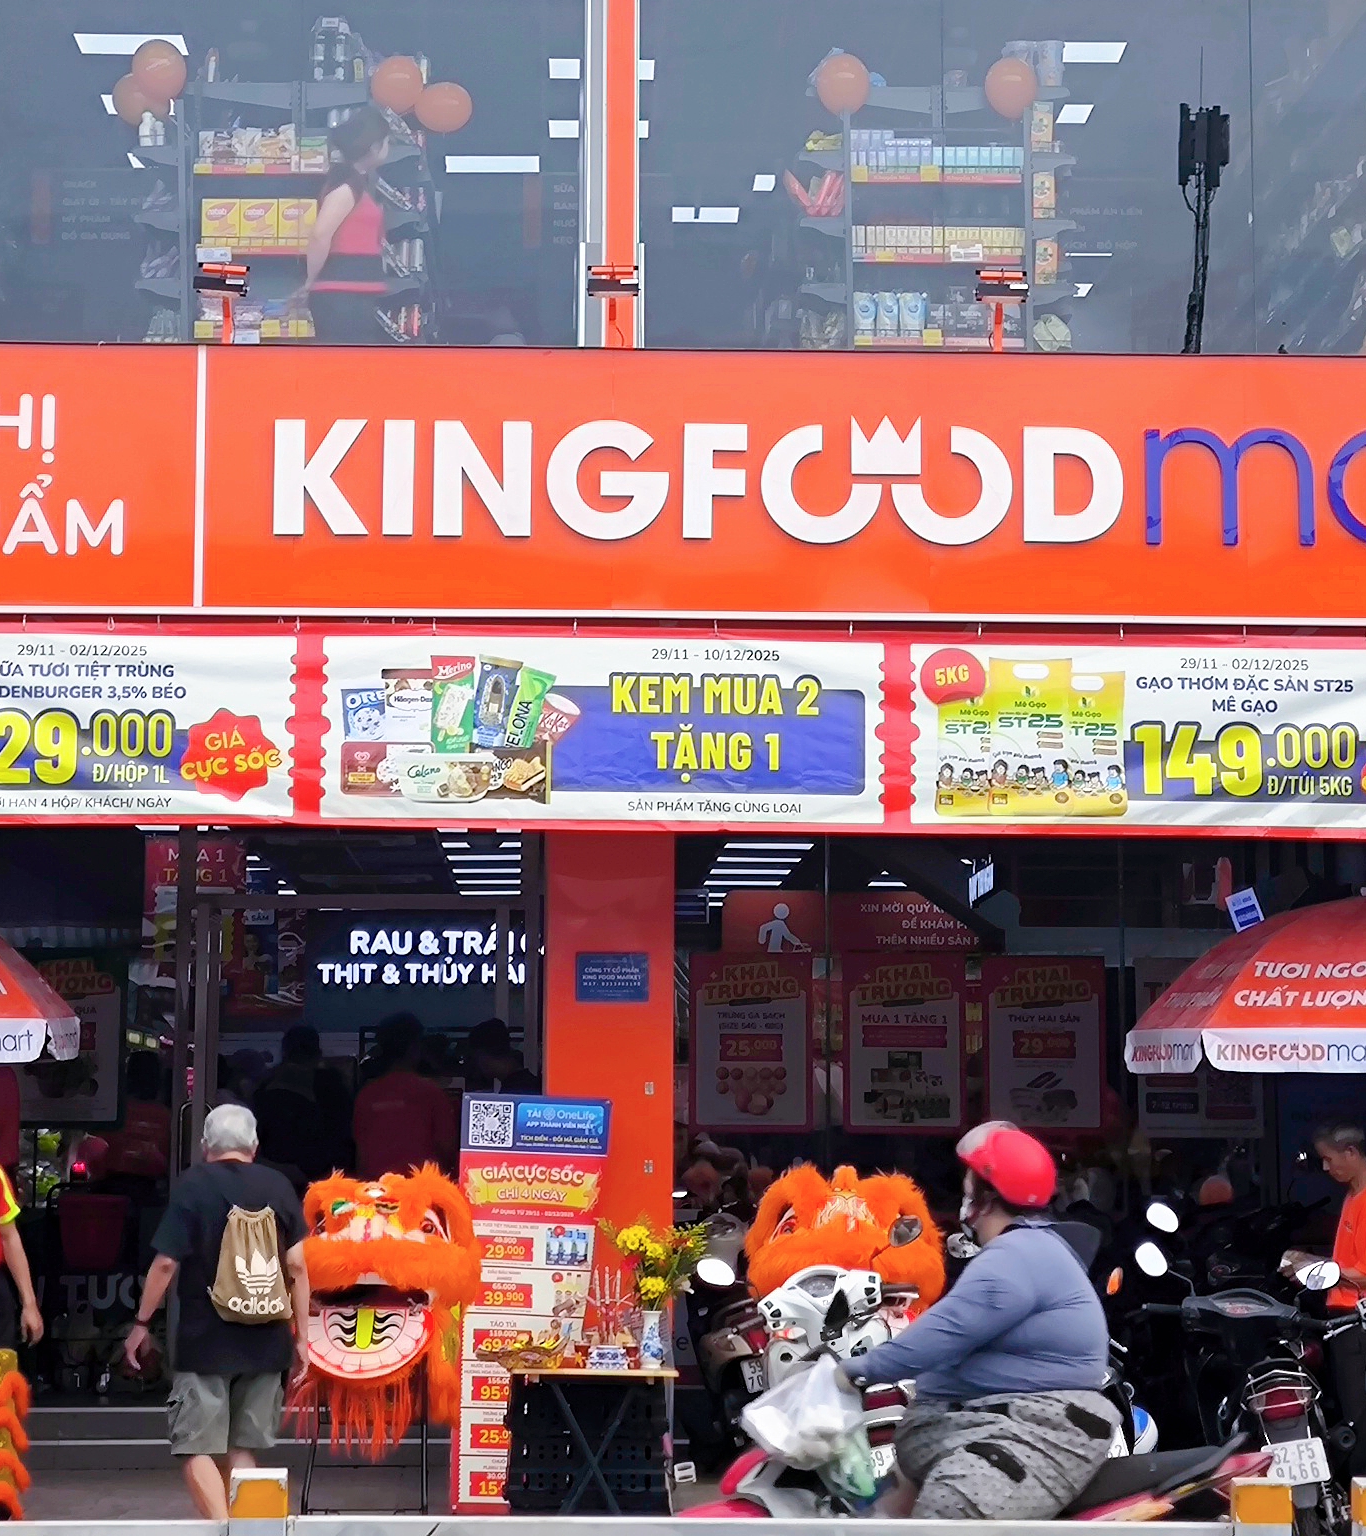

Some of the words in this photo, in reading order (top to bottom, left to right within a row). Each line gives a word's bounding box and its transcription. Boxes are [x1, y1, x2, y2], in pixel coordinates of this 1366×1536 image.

[16, 643, 56, 658] 29/11
[69, 643, 148, 658] 02/12/2025
[650, 647, 689, 663] 29/11
[703, 647, 781, 663] 10/12/2025
[29, 661, 70, 678] TƯƠI
[73, 661, 109, 681] TIỆT
[113, 659, 175, 679] TRÙNG
[437, 661, 473, 677] Merino
[1179, 656, 1219, 671] 29/11
[1231, 657, 1310, 673] 02/12/2025
[934, 664, 970, 687] 5KG
[1135, 676, 1174, 696] GẠO
[1177, 675, 1231, 693] THƠM
[1233, 674, 1269, 696] ĐẶC
[1272, 673, 1310, 694] SẢN
[1313, 678, 1354, 694] ST25
[107, 685, 147, 702] 3,5%
[150, 681, 187, 700] BÉO
[345, 690, 385, 710] ORE
[610, 674, 688, 715] KEM
[701, 675, 785, 716] MUA
[795, 677, 821, 718] 2
[1211, 695, 1238, 713] MÊ
[1240, 698, 1279, 716] GẠO
[998, 713, 1064, 729] ST25
[204, 724, 246, 751] GIÁ
[180, 751, 230, 781] CỰC
[233, 745, 283, 774] SỐC
[650, 723, 753, 783] TẶNG
[763, 731, 780, 770] 1
[1132, 721, 1358, 797] 149.000
[91, 760, 149, 787] Đ/HỘP
[152, 765, 171, 784] 1L
[1266, 769, 1316, 794] Đ/TÚI
[1319, 776, 1353, 797] 5KG
[8, 795, 40, 810] HẠN
[42, 796, 49, 808] 4
[135, 794, 172, 809] NGÀY
[627, 796, 655, 813] SẢN
[657, 796, 696, 813] PHẨM
[698, 798, 732, 815] TẶNG
[734, 798, 770, 814] CÙNG
[772, 800, 802, 816] LOẠI
[860, 903, 879, 914] XIN
[906, 901, 930, 915] QUÝ
[349, 929, 413, 955] RAU
[418, 930, 440, 955] &
[316, 962, 377, 990] THỊT
[381, 963, 401, 985] &
[404, 955, 473, 985] THỦY
[1253, 959, 1314, 979] TƯƠI
[1234, 983, 1299, 1008] CHẤT
[481, 1162, 512, 1181] GIÁ
[513, 1164, 547, 1184] CỰC
[550, 1164, 584, 1184] SỐC
[497, 1186, 519, 1200] CHỈ
[520, 1188, 530, 1199] 4
[531, 1187, 567, 1202] NGÀY
[485, 1244, 525, 1259] 29.000
[227, 1292, 286, 1316] adidas
[483, 1291, 524, 1305] 39.900
